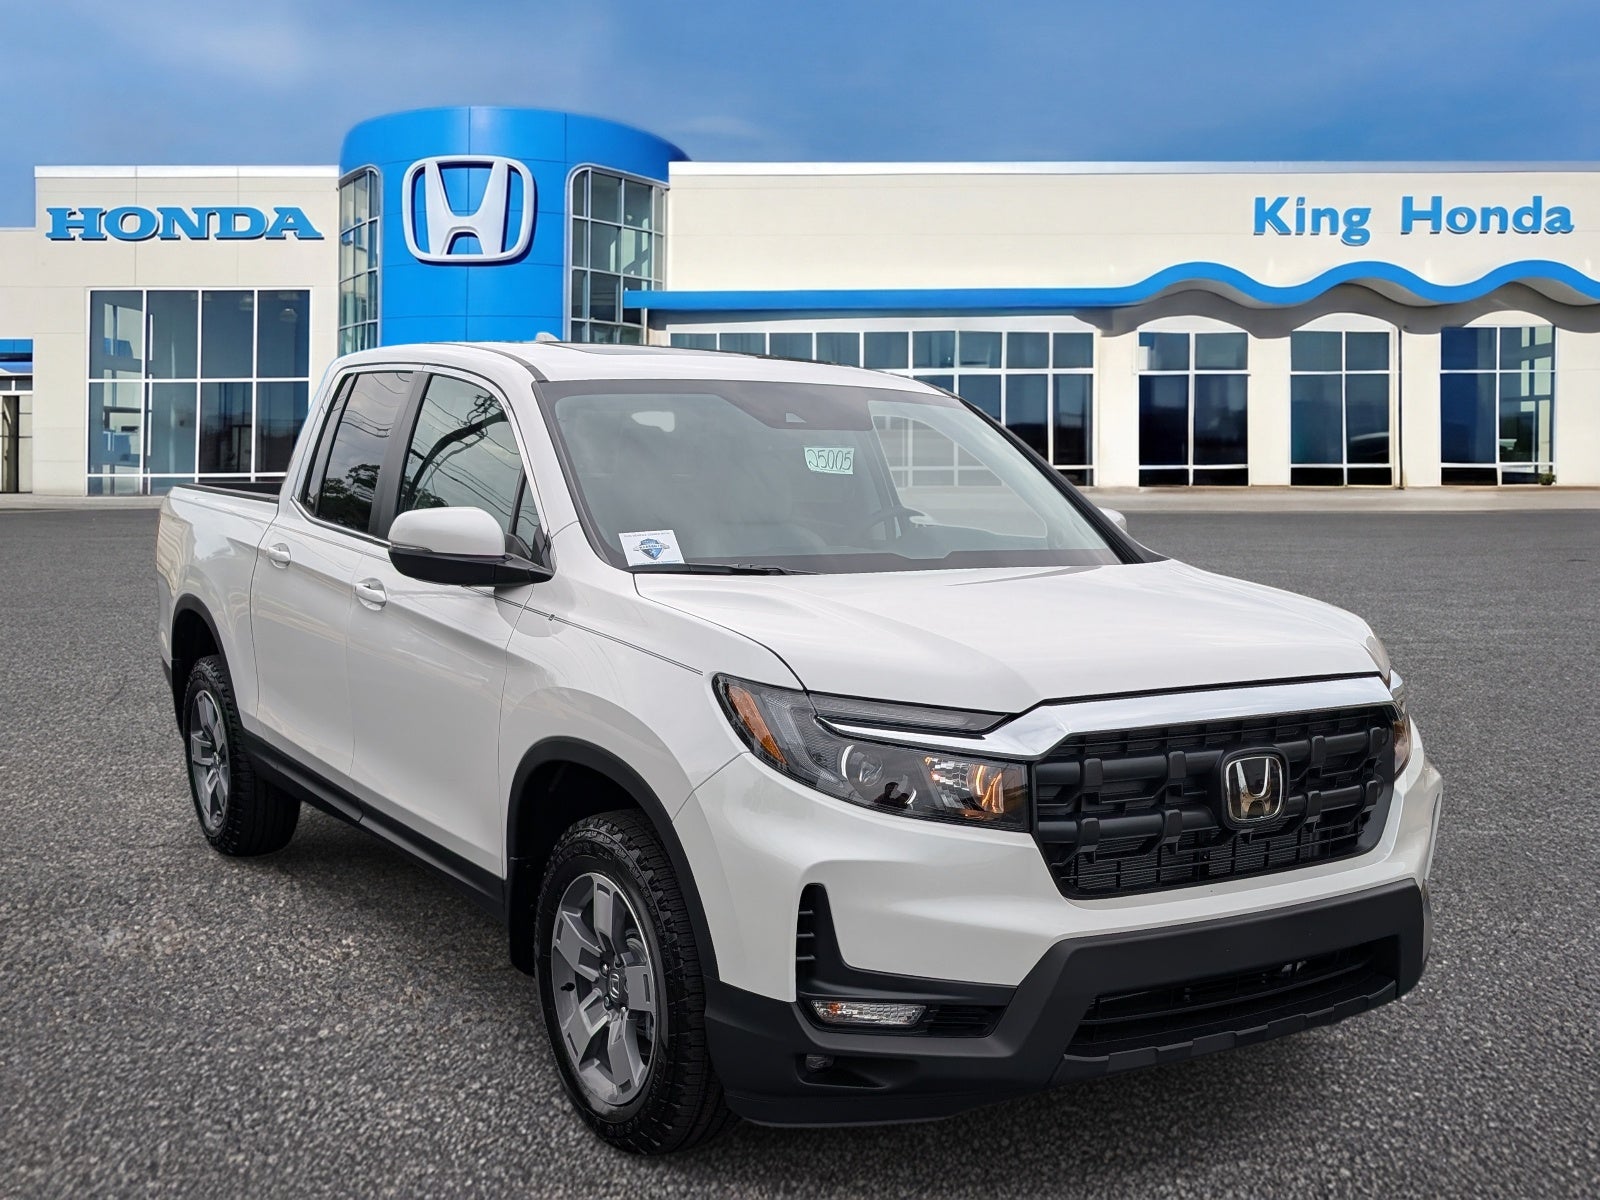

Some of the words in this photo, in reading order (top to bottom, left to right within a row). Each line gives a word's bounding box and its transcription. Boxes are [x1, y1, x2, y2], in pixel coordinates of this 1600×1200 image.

[46, 206, 324, 241] HONDA
[1253, 196, 1372, 247] King
[1400, 195, 1575, 235] Honda
[806, 448, 852, 471] 25005
